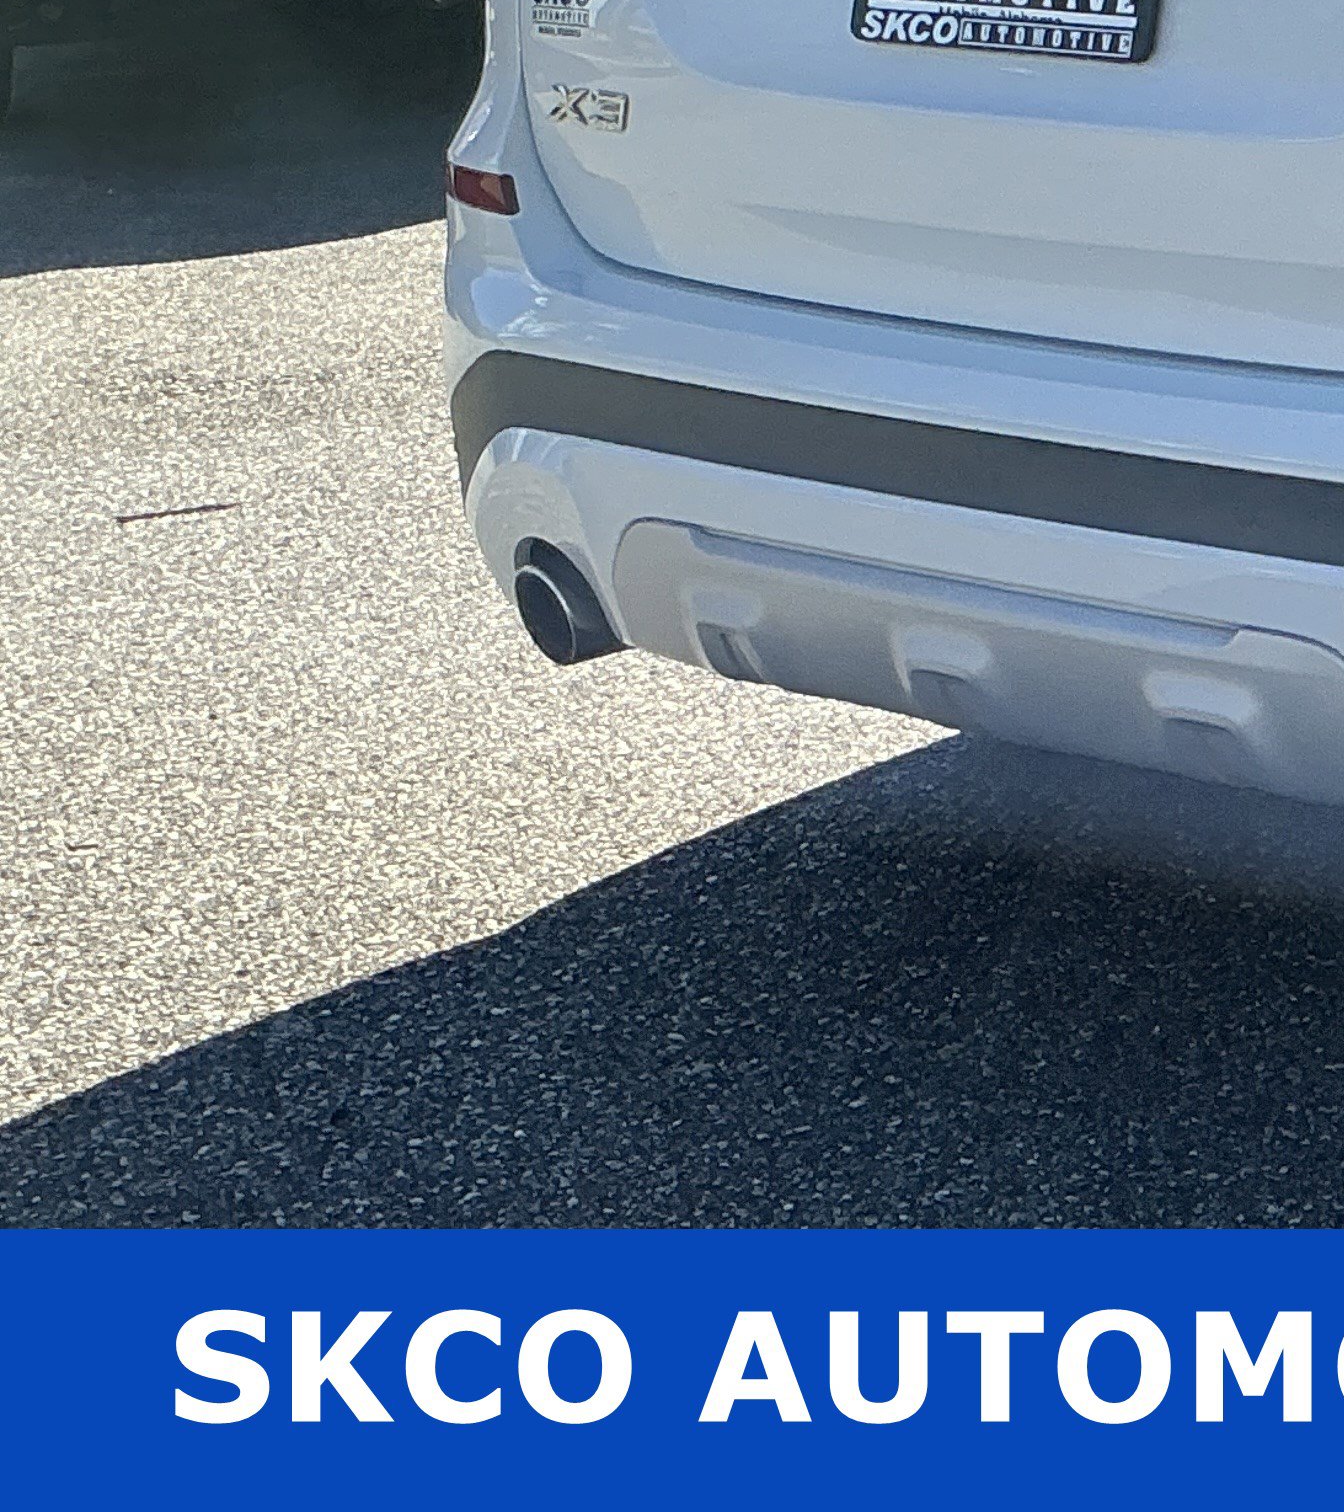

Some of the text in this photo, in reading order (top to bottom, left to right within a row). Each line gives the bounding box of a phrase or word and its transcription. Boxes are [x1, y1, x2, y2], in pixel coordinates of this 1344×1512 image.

[860, 9, 1132, 55] SKCO AUTOMOTIVE
[547, 85, 631, 134] X3
